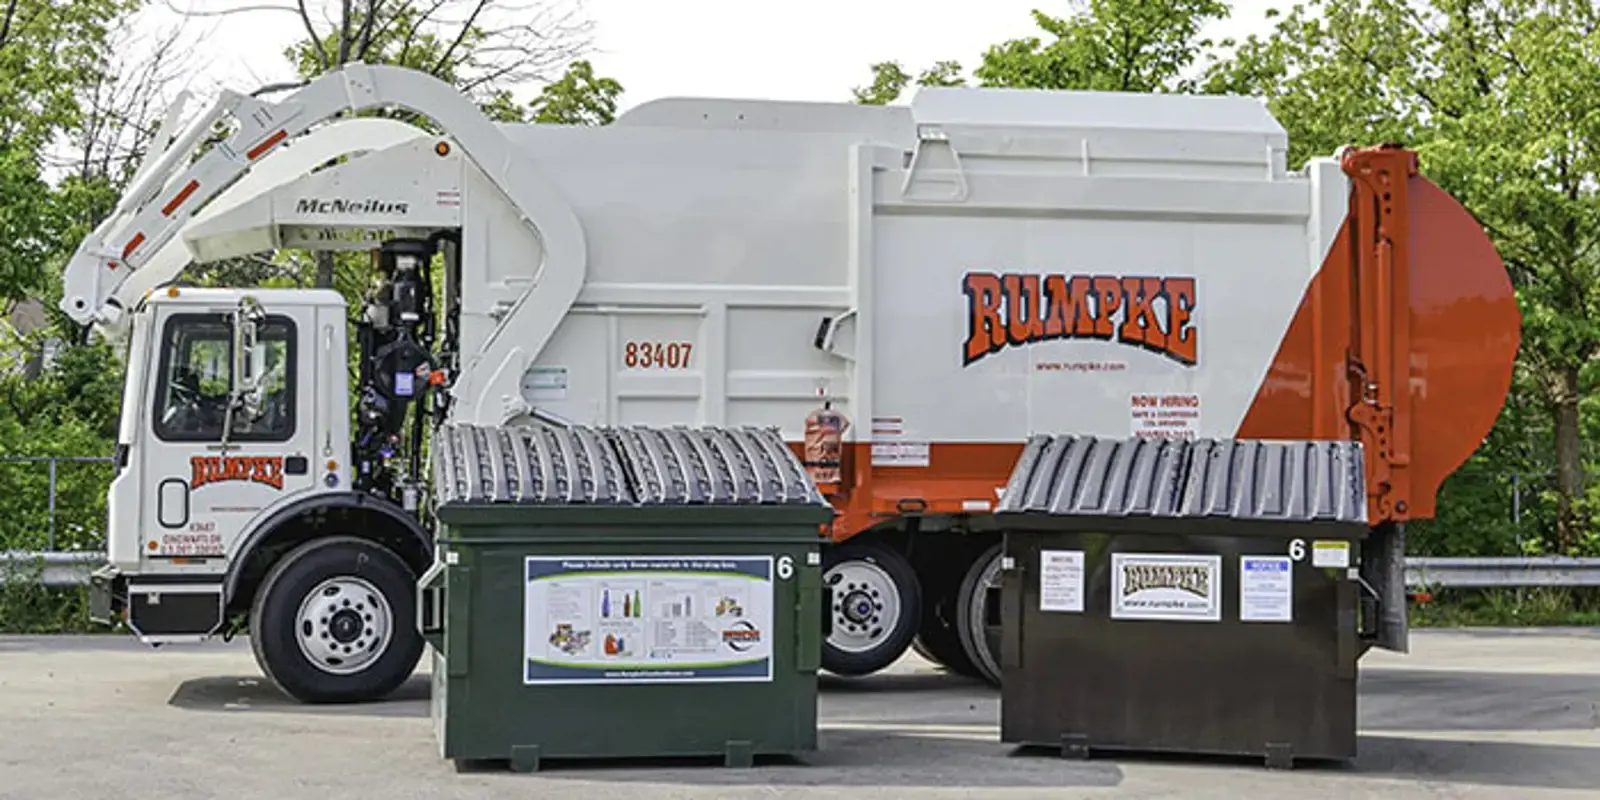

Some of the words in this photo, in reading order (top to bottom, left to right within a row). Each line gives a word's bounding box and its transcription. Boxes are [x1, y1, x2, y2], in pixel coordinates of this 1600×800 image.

[296, 199, 410, 214] McNeilus
[963, 272, 1197, 367] RUMPKE
[625, 342, 692, 369] 83407
[1036, 361, 1126, 372] www.rumpke.com
[1132, 395, 1158, 407] NOW
[1161, 395, 1199, 407] HIRING
[190, 456, 283, 491] RUMPKE
[1289, 538, 1305, 560] 6
[777, 556, 793, 579] 6
[1123, 566, 1209, 597] RUMPKE
[1124, 600, 1209, 609] www.rumpke.com
